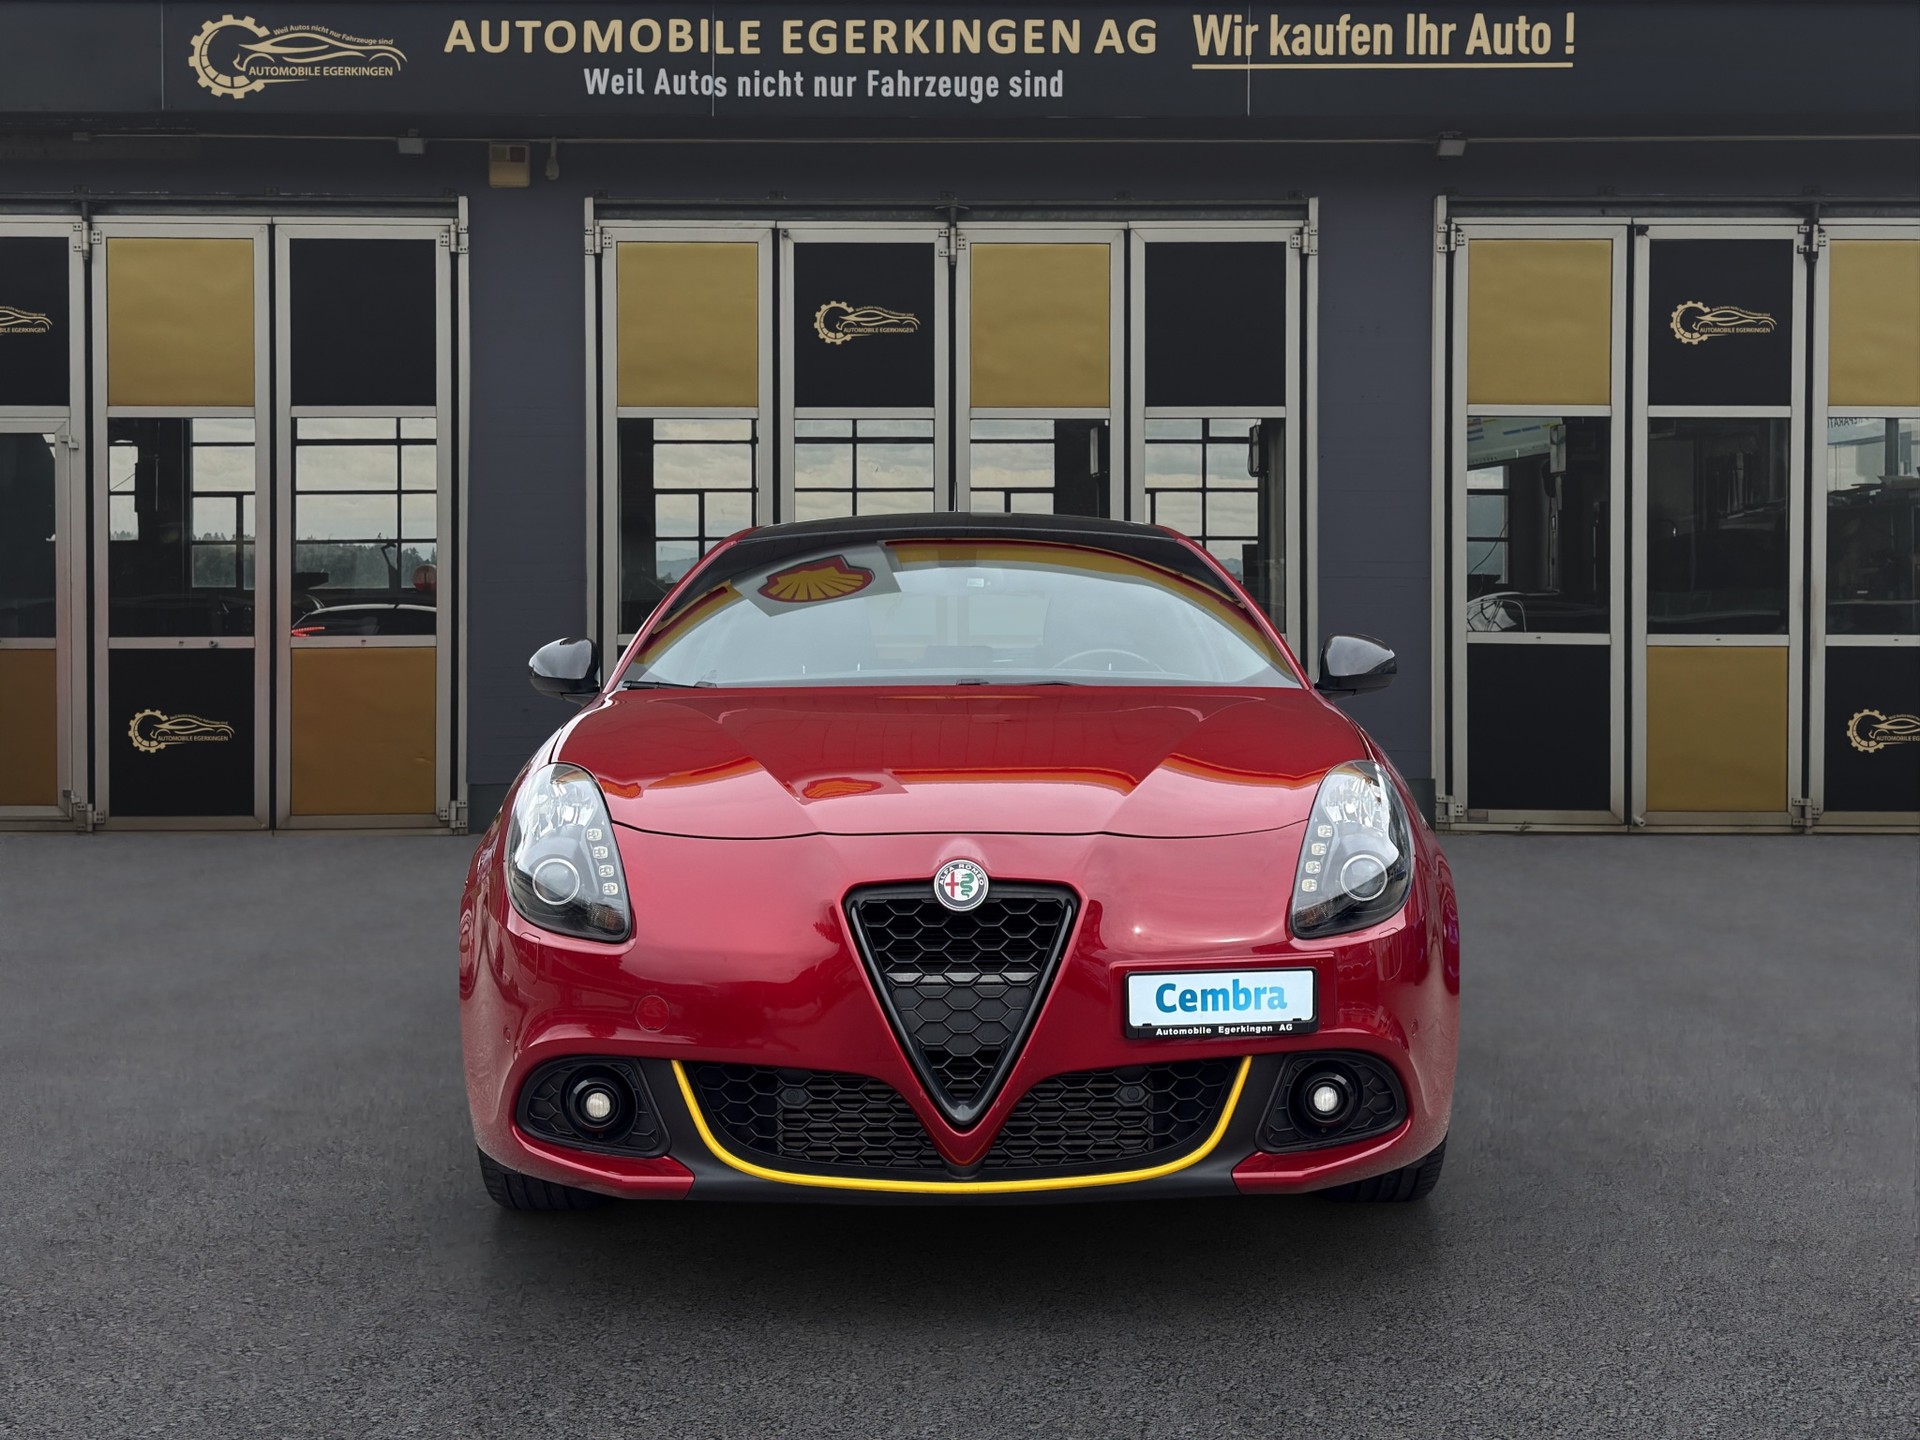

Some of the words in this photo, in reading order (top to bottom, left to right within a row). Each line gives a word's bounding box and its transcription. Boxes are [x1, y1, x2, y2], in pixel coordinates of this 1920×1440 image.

[273, 26, 288, 36] Weil
[311, 25, 329, 34] nicht
[330, 30, 342, 38] nur
[342, 33, 377, 45] Fahrzeuge
[444, 19, 761, 54] AUTOMOBILE
[782, 19, 1081, 54] EGERKINGEN
[1094, 19, 1157, 54] AG
[1193, 14, 1259, 56] Wir
[1269, 13, 1393, 56] kaufen
[1406, 13, 1457, 55] Ihr
[1465, 13, 1552, 55] Auto
[249, 66, 321, 76] AUTOMOBILE
[323, 66, 394, 76] EGERKINGEN
[584, 68, 645, 95] Weil
[654, 68, 727, 97] Autos
[738, 70, 804, 97] nicht
[814, 76, 857, 97] nur
[867, 70, 999, 104] Fahrzeuge
[1009, 69, 1063, 97] sind
[939, 866, 955, 885] ALFA
[959, 864, 984, 886] ROMEO
[1155, 979, 1287, 1013] Cembra
[1156, 1026, 1212, 1036] Automobile
[1218, 1024, 1273, 1034] Egerkingen
[1279, 1023, 1293, 1031] AG
